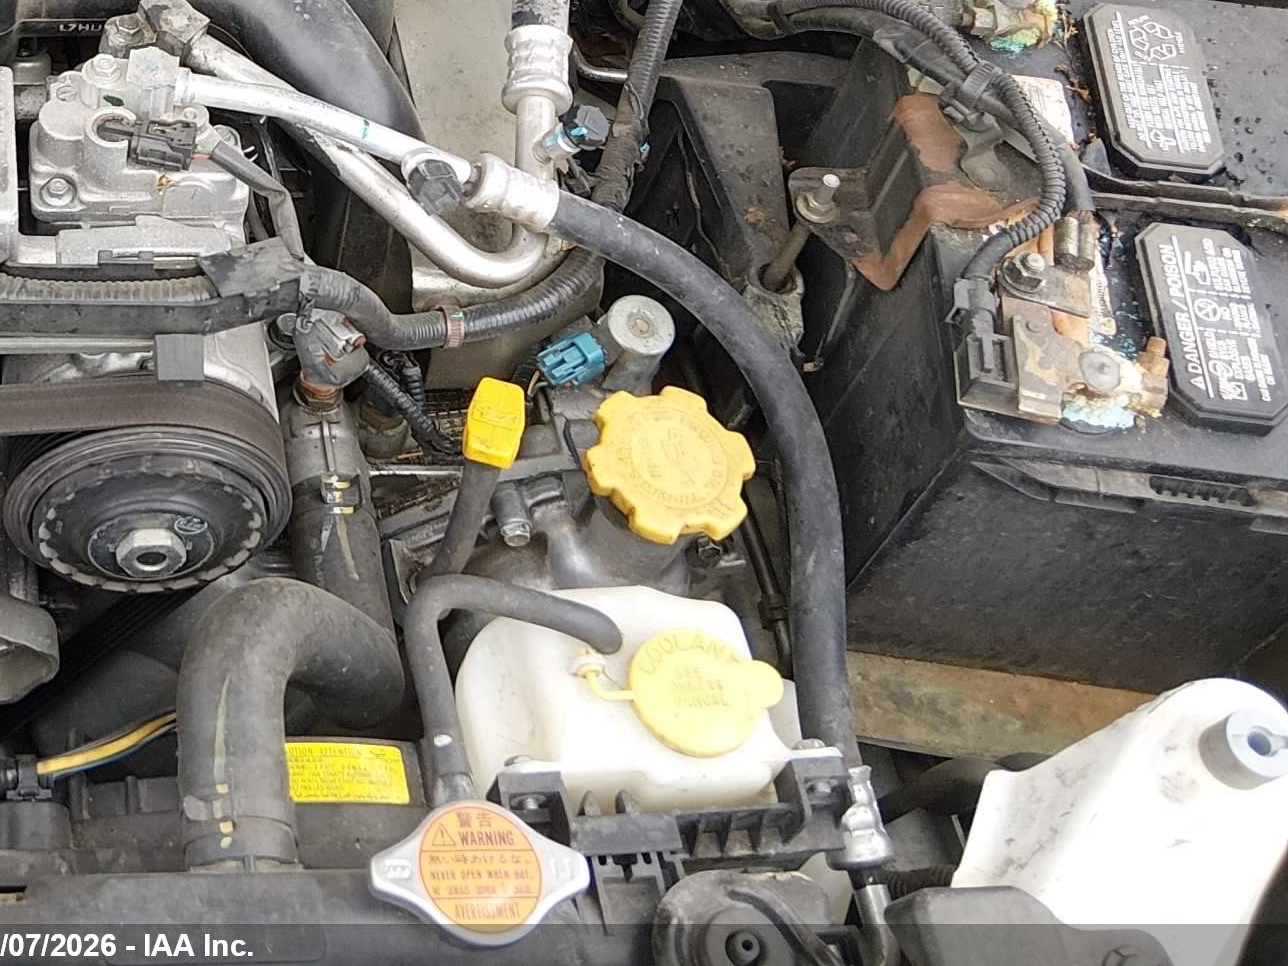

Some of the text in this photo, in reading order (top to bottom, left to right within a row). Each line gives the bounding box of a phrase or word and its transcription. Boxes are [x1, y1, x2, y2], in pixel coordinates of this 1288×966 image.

[1158, 244, 1184, 297] POISON
[1173, 311, 1202, 374] DANGER
[456, 811, 494, 829] 警告
[457, 830, 515, 847] WARNING
[430, 869, 457, 881] NEVER
[461, 869, 483, 880] OPEN
[485, 868, 510, 879] WHEN
